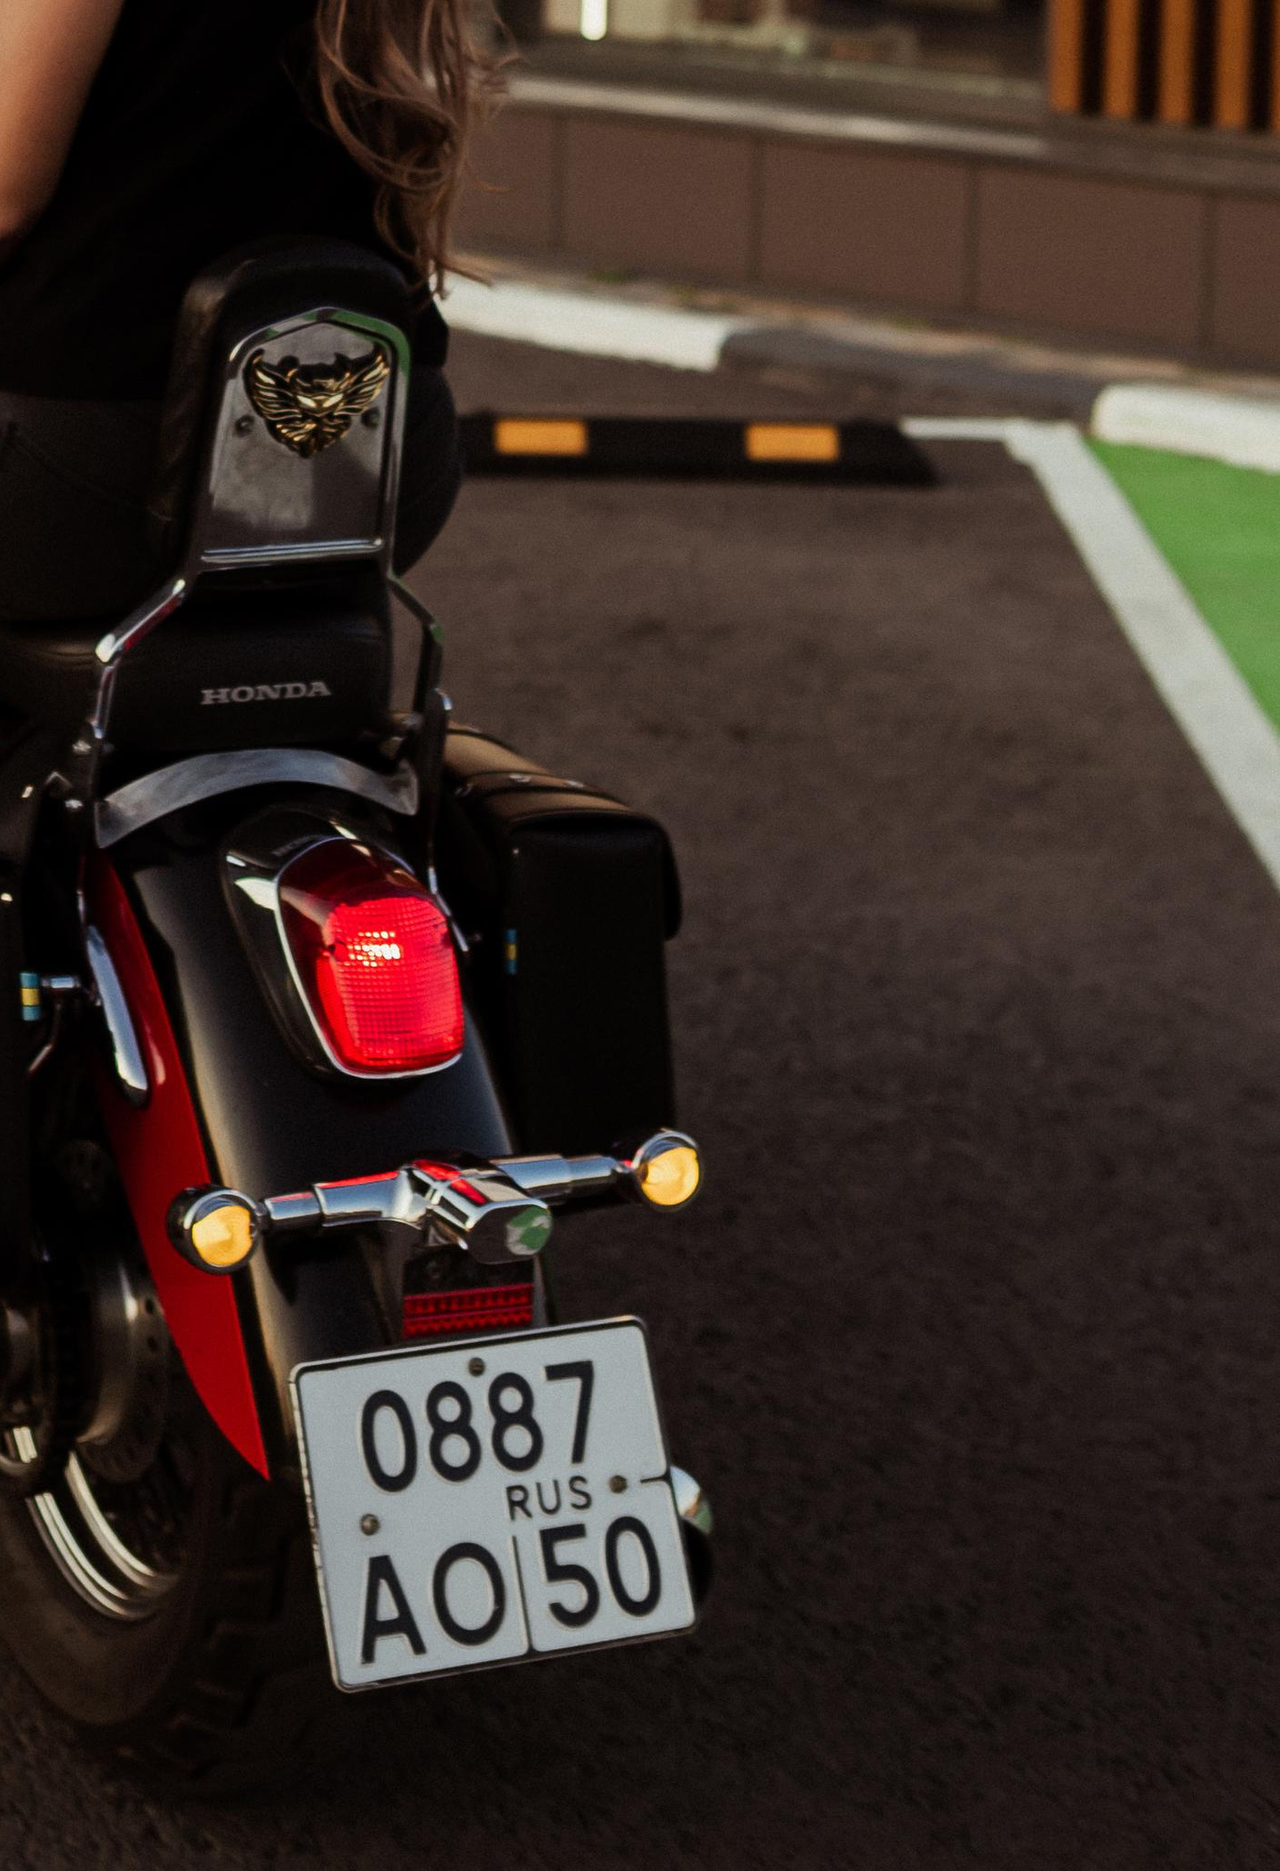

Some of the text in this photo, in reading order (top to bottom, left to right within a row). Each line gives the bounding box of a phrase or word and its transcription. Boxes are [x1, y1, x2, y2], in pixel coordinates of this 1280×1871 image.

[200, 681, 332, 705] HONDA
[361, 1360, 594, 1493] 0887
[505, 1476, 593, 1521] RUS
[361, 1516, 662, 1665] AO 50
